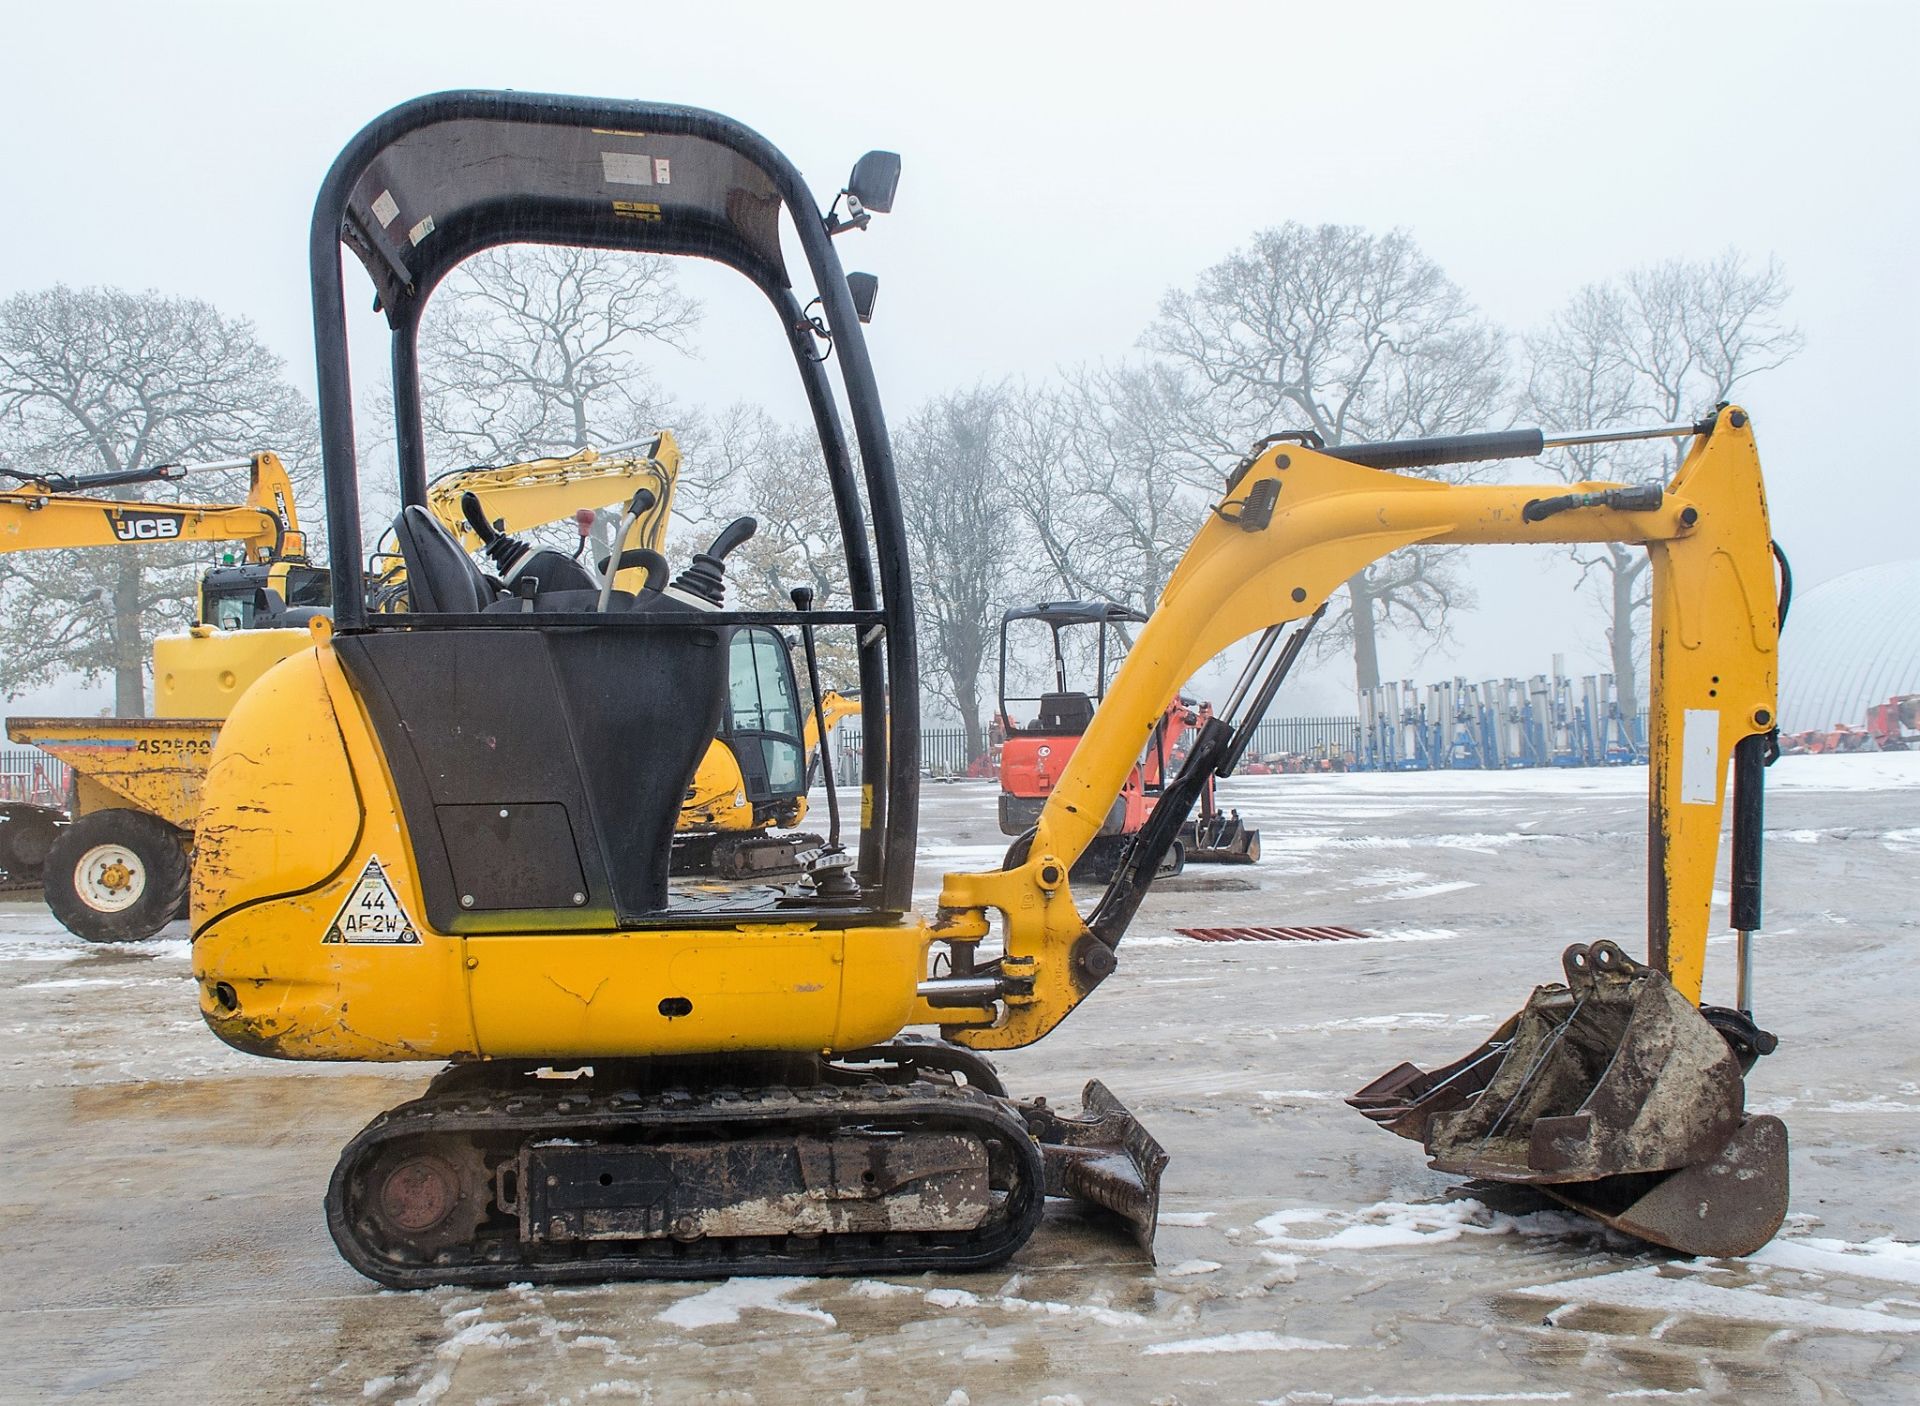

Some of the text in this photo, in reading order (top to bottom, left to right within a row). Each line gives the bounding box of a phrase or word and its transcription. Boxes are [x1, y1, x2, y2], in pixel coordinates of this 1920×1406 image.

[117, 518, 179, 539] JCB
[361, 892, 385, 910] 44
[346, 914, 397, 932] AF2W
